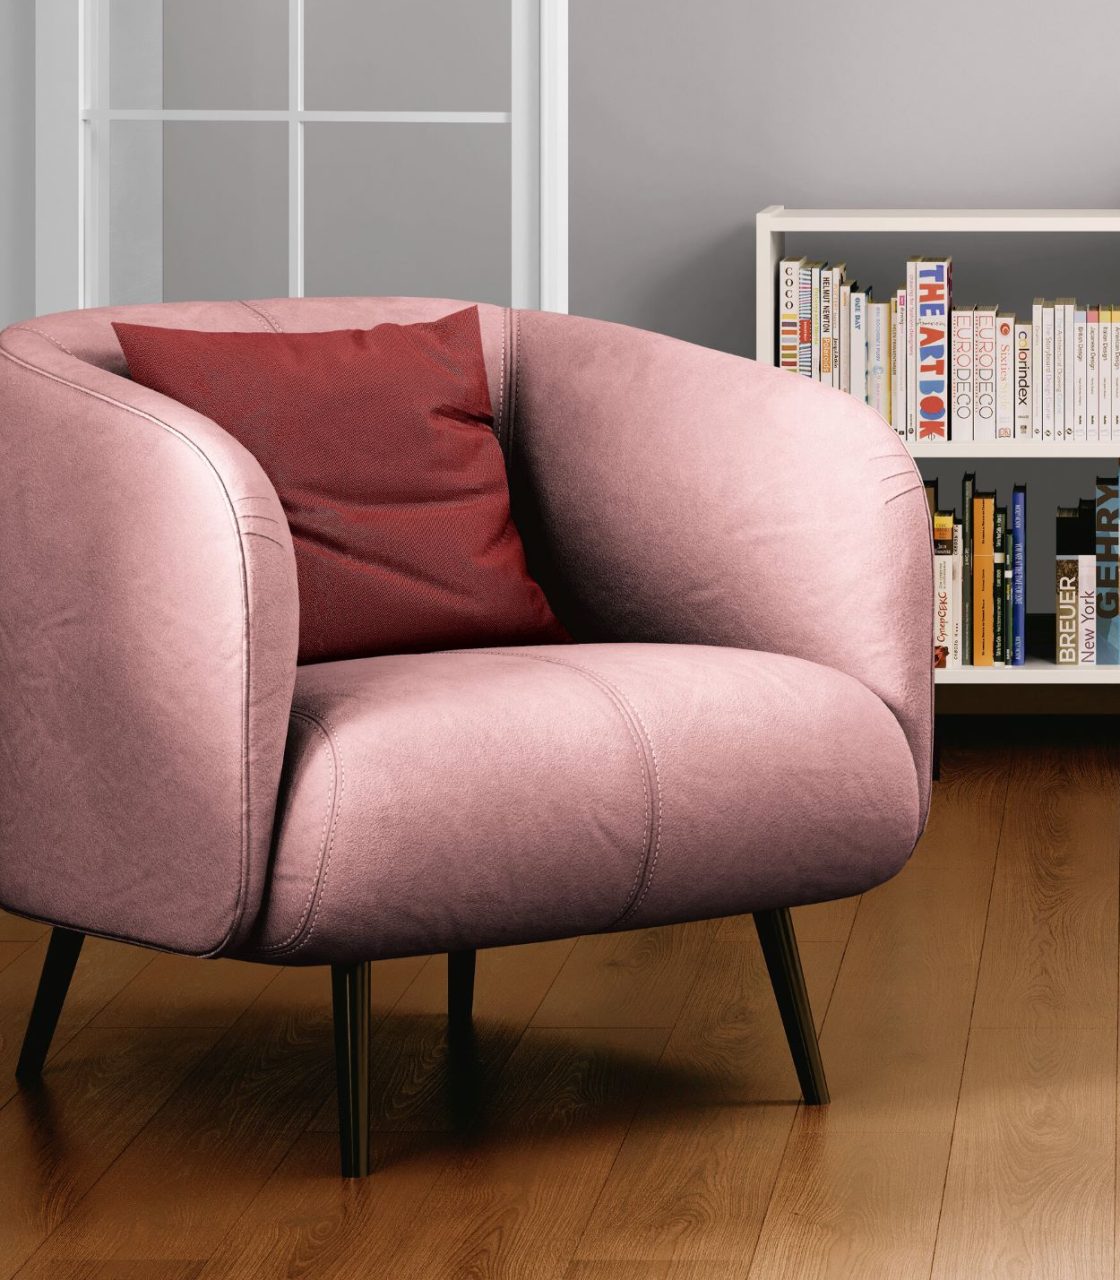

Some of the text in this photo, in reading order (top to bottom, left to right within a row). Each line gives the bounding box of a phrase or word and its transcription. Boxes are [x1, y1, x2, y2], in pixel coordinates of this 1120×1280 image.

[785, 267, 794, 309] COCO
[822, 277, 830, 303] HELMUT
[822, 305, 830, 333] NEWTON
[919, 264, 945, 316] THE
[919, 327, 946, 375] ART
[957, 315, 971, 419] EURODECO
[979, 315, 993, 419] EURODECO
[1000, 344, 1010, 381] Sixties
[1018, 331, 1030, 406] colorindex
[1096, 485, 1119, 619] GEHRY
[1059, 576, 1076, 663] BREUER
[1080, 590, 1094, 663] New York
